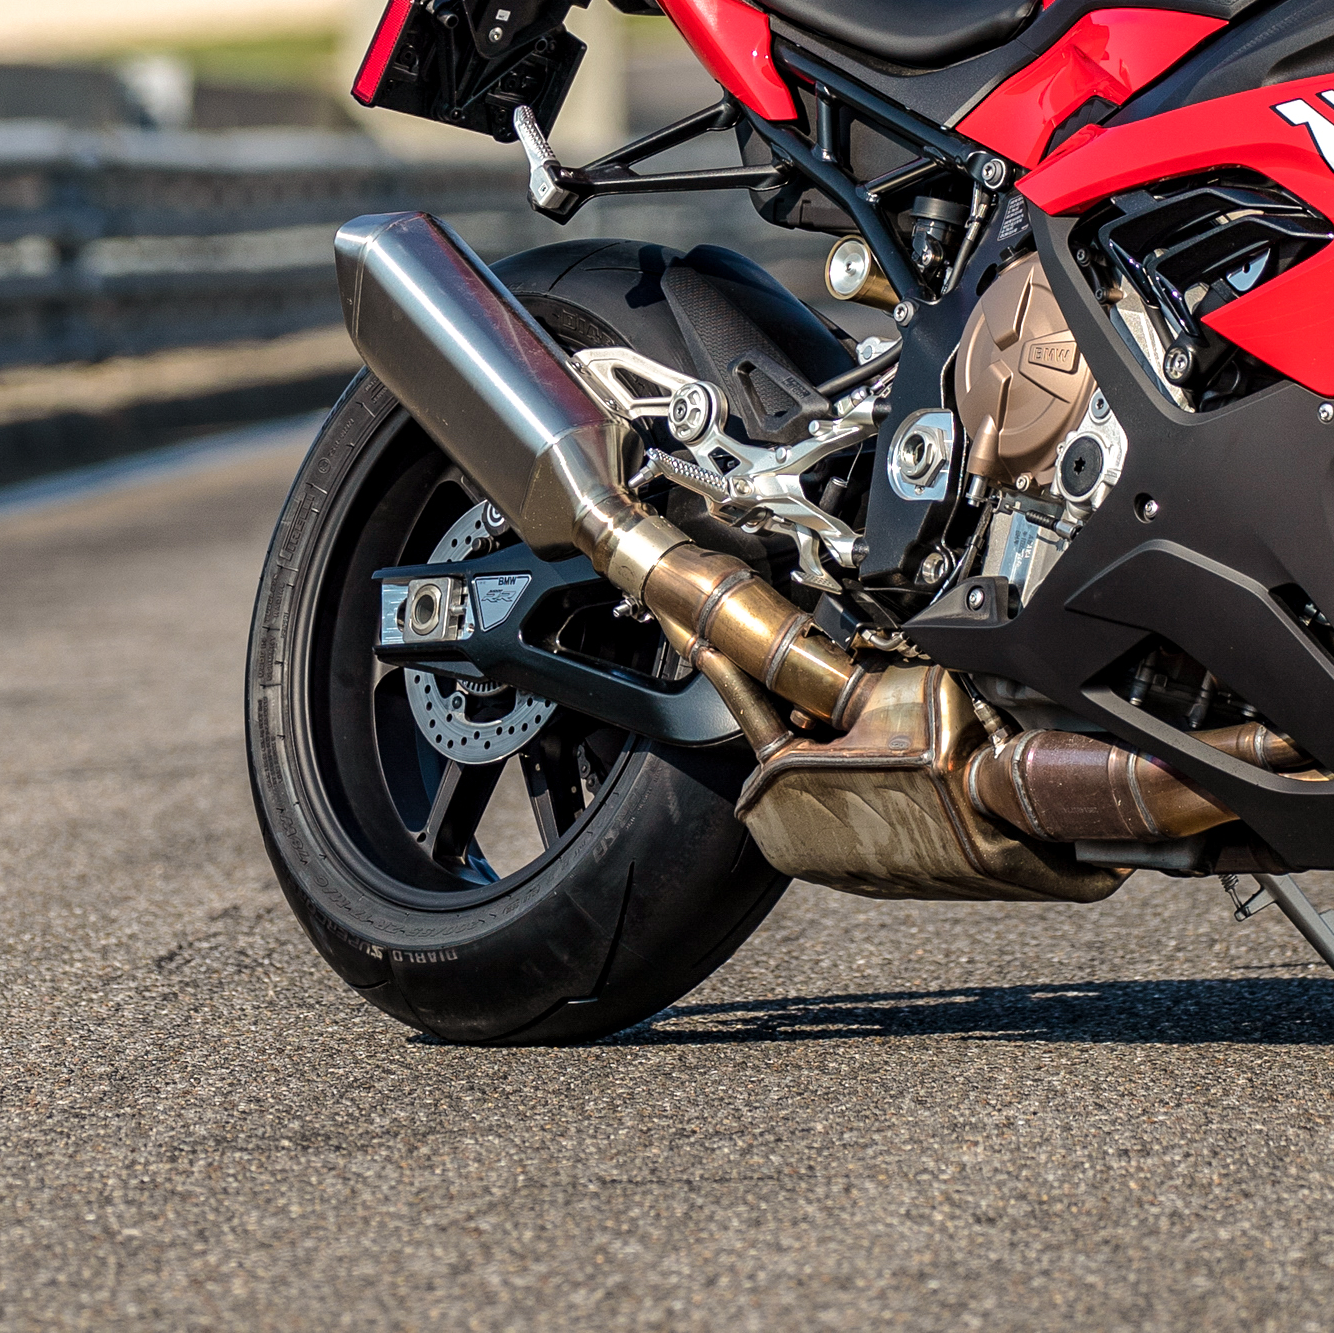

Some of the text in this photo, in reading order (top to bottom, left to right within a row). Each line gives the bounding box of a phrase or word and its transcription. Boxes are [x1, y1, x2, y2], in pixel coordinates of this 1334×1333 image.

[1033, 347, 1070, 362] BMW
[279, 492, 316, 561] PIRELLI
[498, 576, 517, 586] BMW
[392, 948, 458, 964] DIABLO
